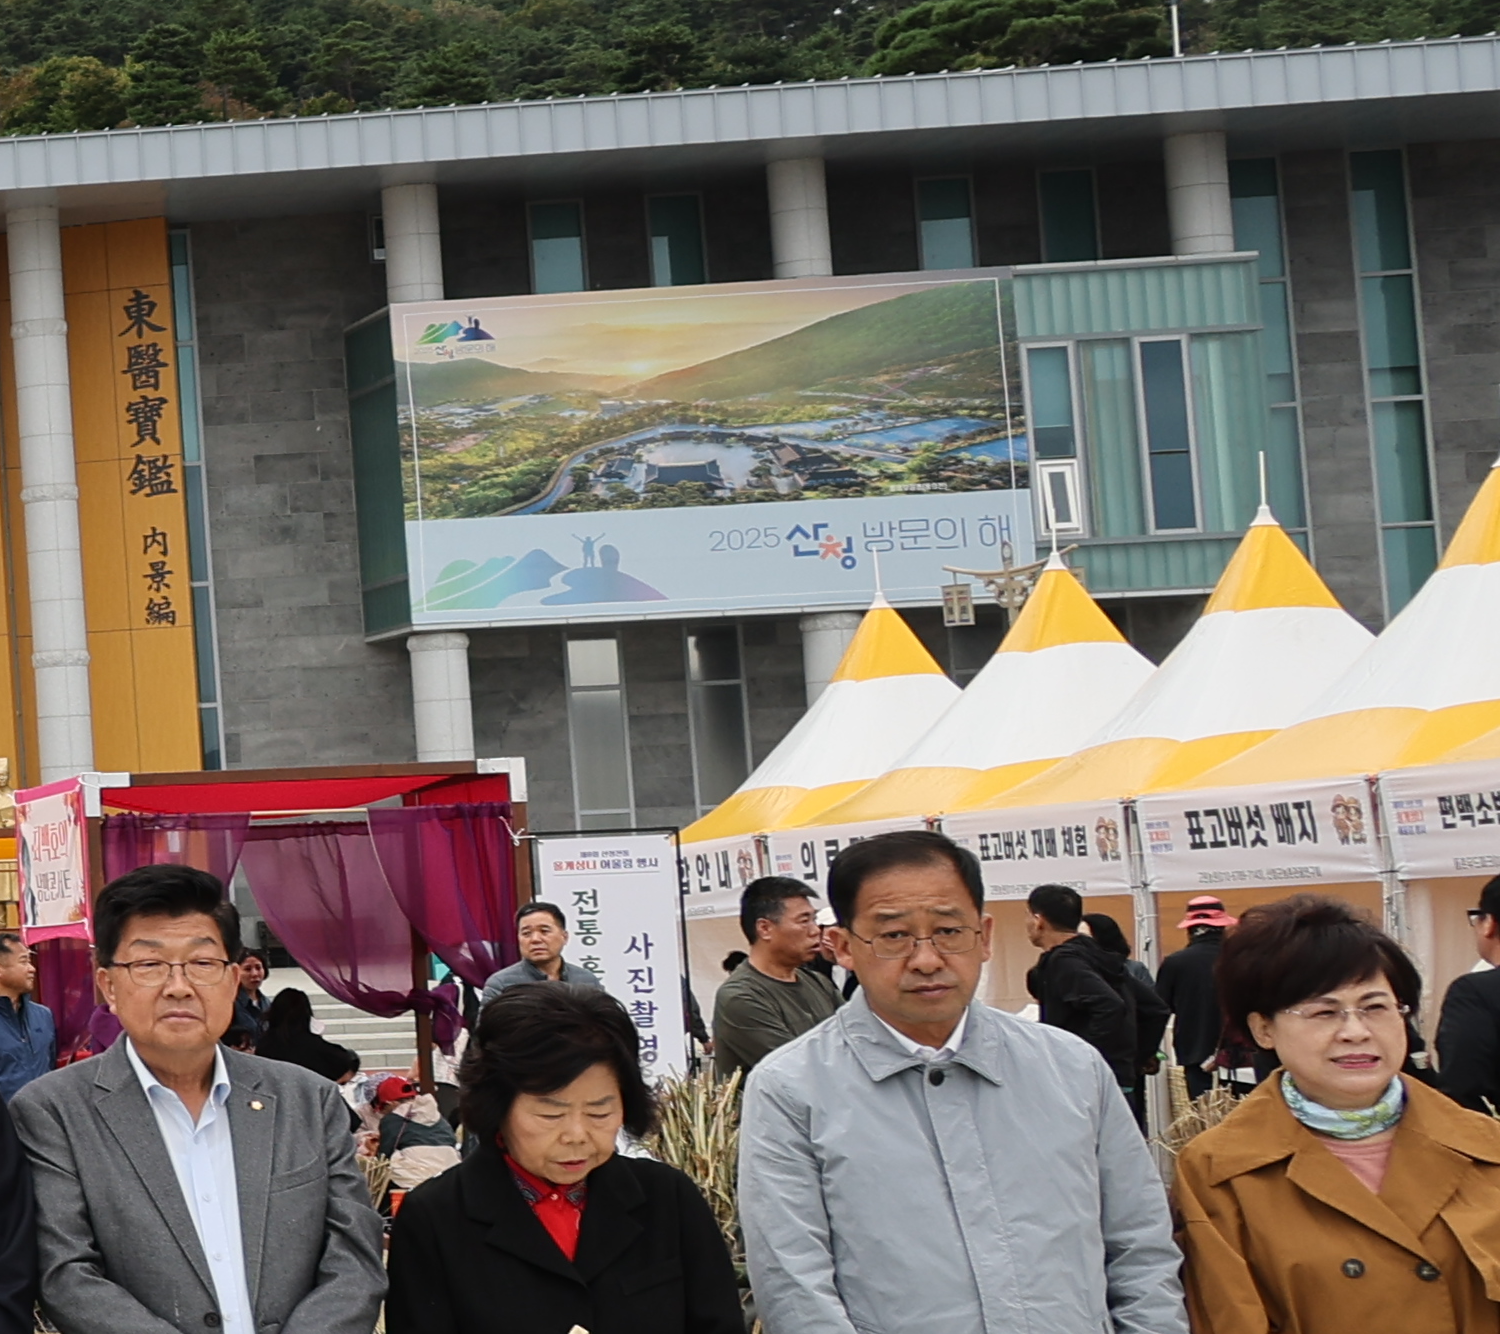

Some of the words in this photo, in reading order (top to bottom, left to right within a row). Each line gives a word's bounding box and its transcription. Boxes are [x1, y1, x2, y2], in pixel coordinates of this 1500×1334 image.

[117, 289, 179, 498] 東醫寶鑑
[709, 527, 781, 552] 2025
[786, 523, 857, 569] 산청
[863, 517, 968, 553] 방문의
[978, 515, 1010, 547] 해
[32, 820, 70, 862] 최백호의
[978, 829, 1029, 862] 표고버섯
[1061, 825, 1088, 857] 체험
[1184, 804, 1268, 851] 표고버섯
[1270, 800, 1319, 845] 배지
[554, 860, 597, 871] 올게심니
[636, 858, 659, 868] 행사
